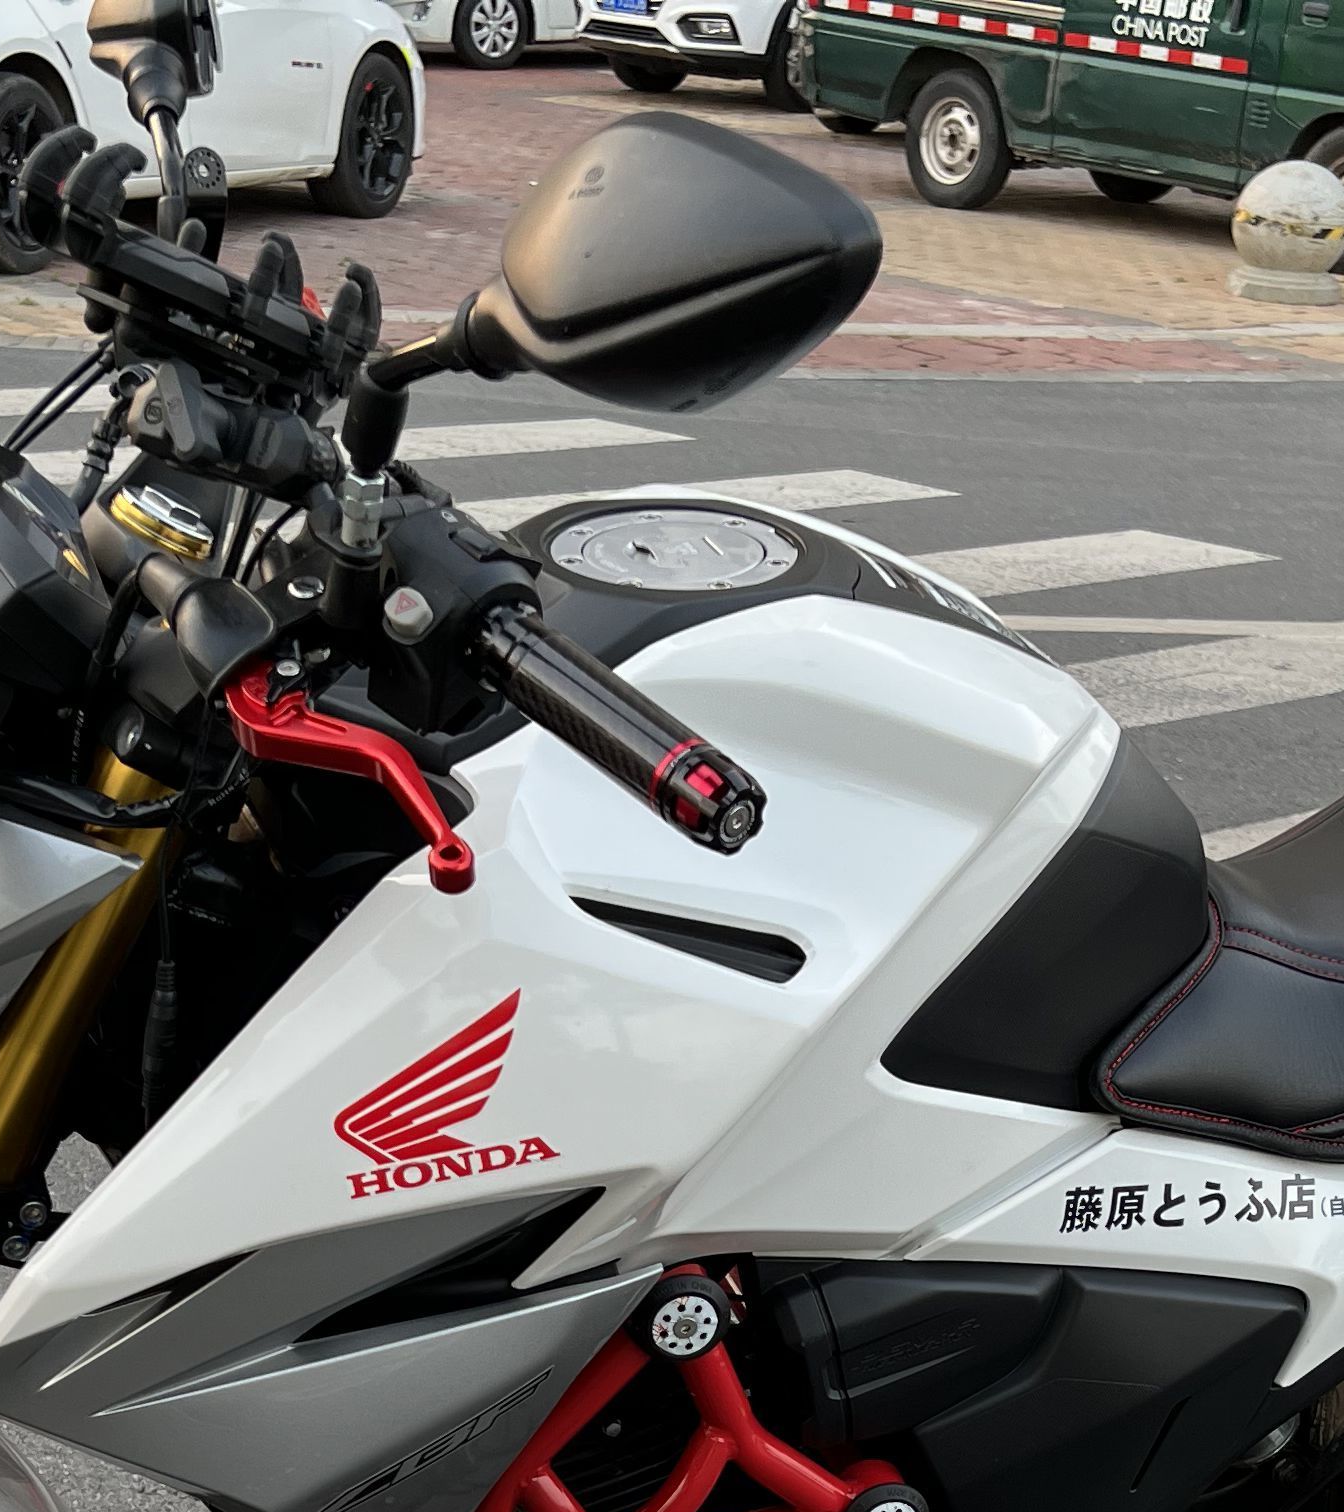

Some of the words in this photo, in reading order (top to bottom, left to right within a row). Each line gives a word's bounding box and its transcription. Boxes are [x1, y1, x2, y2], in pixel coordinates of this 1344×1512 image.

[1112, 14, 1165, 41] CHINA
[1166, 22, 1209, 48] POST
[347, 1136, 561, 1199] HONDA
